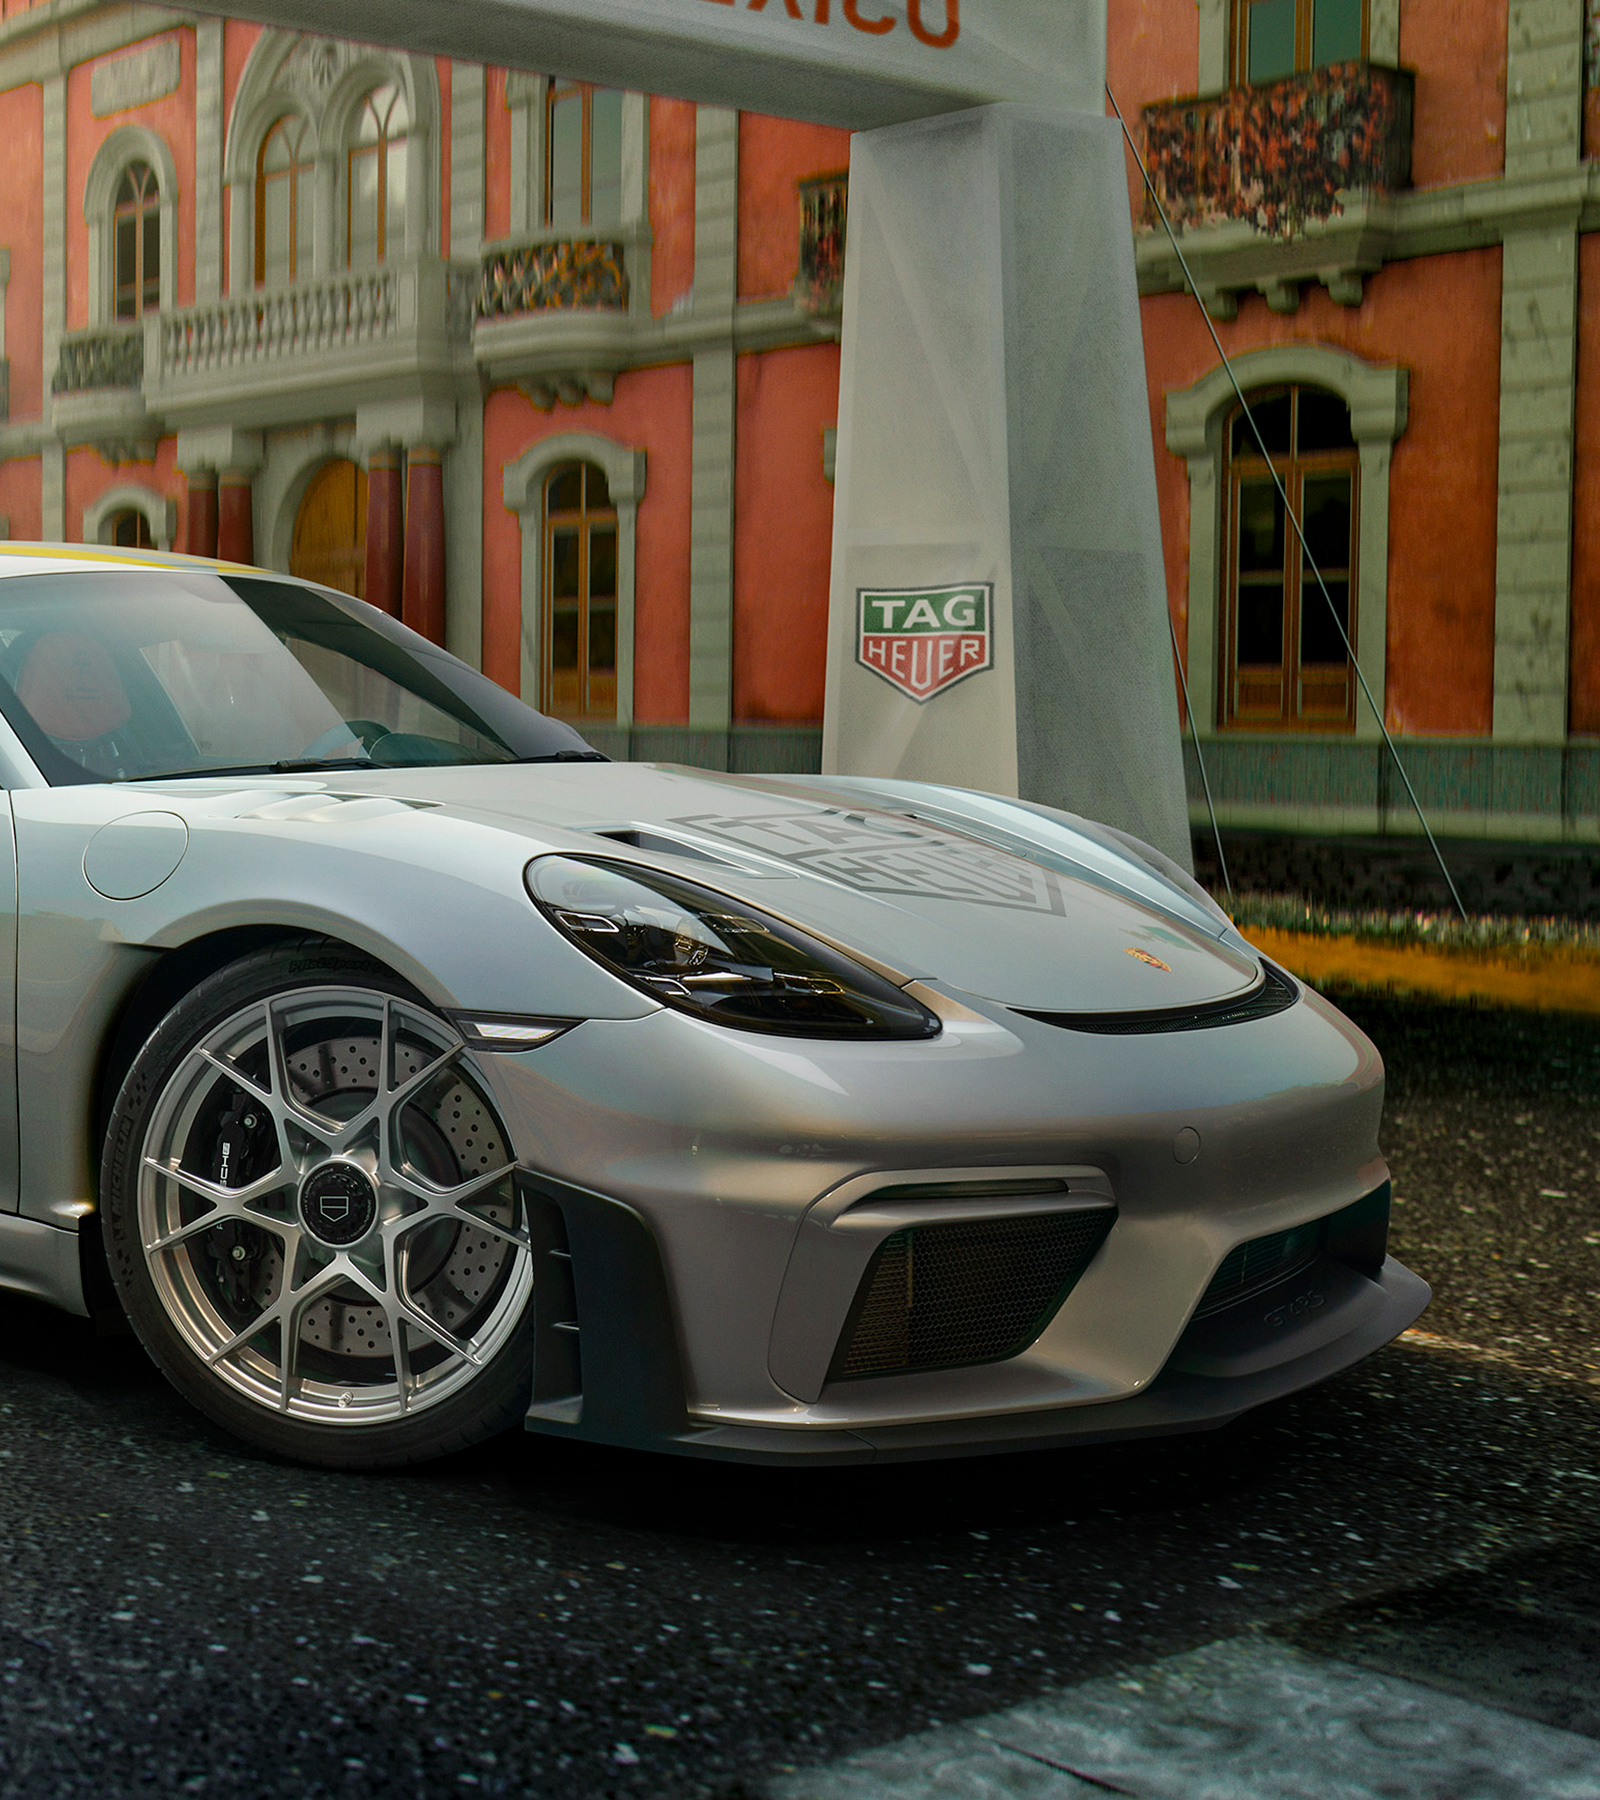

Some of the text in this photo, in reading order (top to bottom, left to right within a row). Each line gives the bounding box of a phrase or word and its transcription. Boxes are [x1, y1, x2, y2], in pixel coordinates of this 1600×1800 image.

[872, 594, 976, 629] TAG
[868, 638, 980, 690] HEUER
[816, 843, 1038, 904] HEUER
[110, 1114, 134, 1217] MICHELIN
